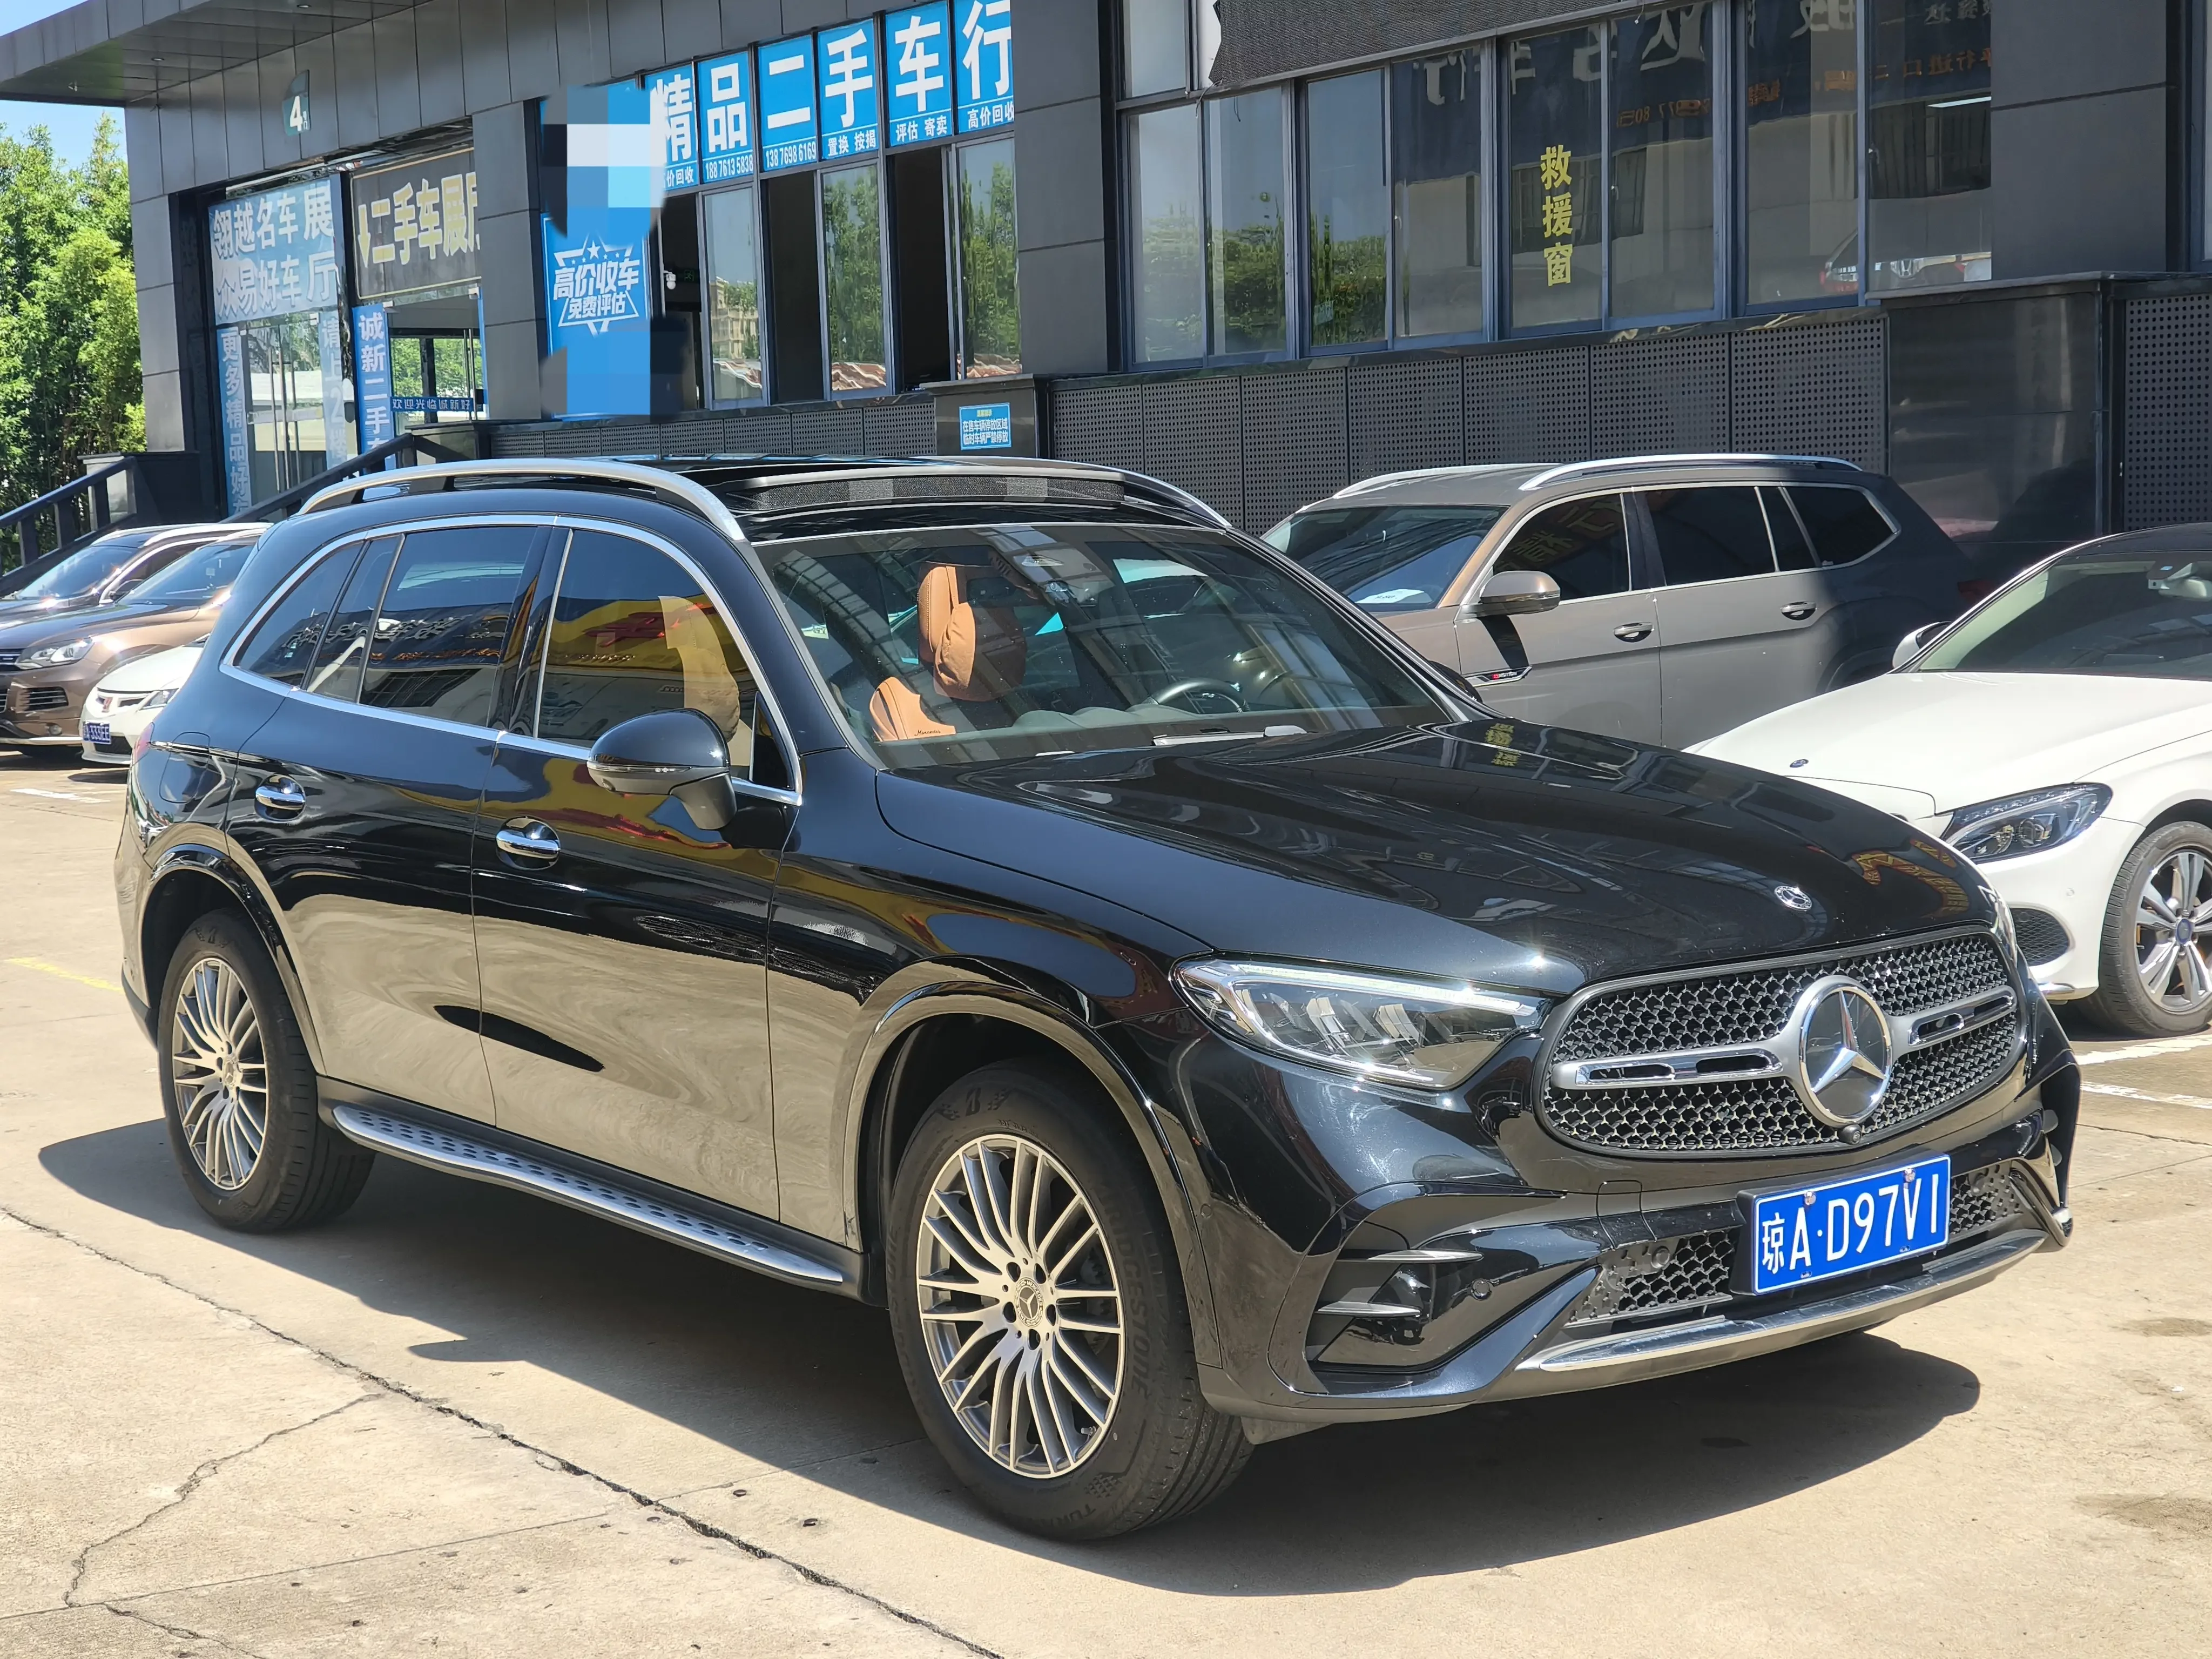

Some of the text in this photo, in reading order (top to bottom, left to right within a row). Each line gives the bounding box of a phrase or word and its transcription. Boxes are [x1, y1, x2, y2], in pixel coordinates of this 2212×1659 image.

[290, 96, 302, 131] 4
[967, 101, 1014, 129] 高价回收
[896, 115, 947, 142] 评估 寄卖
[766, 141, 816, 168] 138 7698 6169
[828, 130, 876, 157] 置换 按揭
[663, 166, 694, 187] 价回收
[705, 154, 753, 180] 188 7613 5838
[1541, 144, 1573, 287] 救援窗
[554, 258, 640, 300] 高价收车
[568, 291, 626, 320] 免费评估
[1762, 1173, 1940, 1275] 琼A·D97V1
